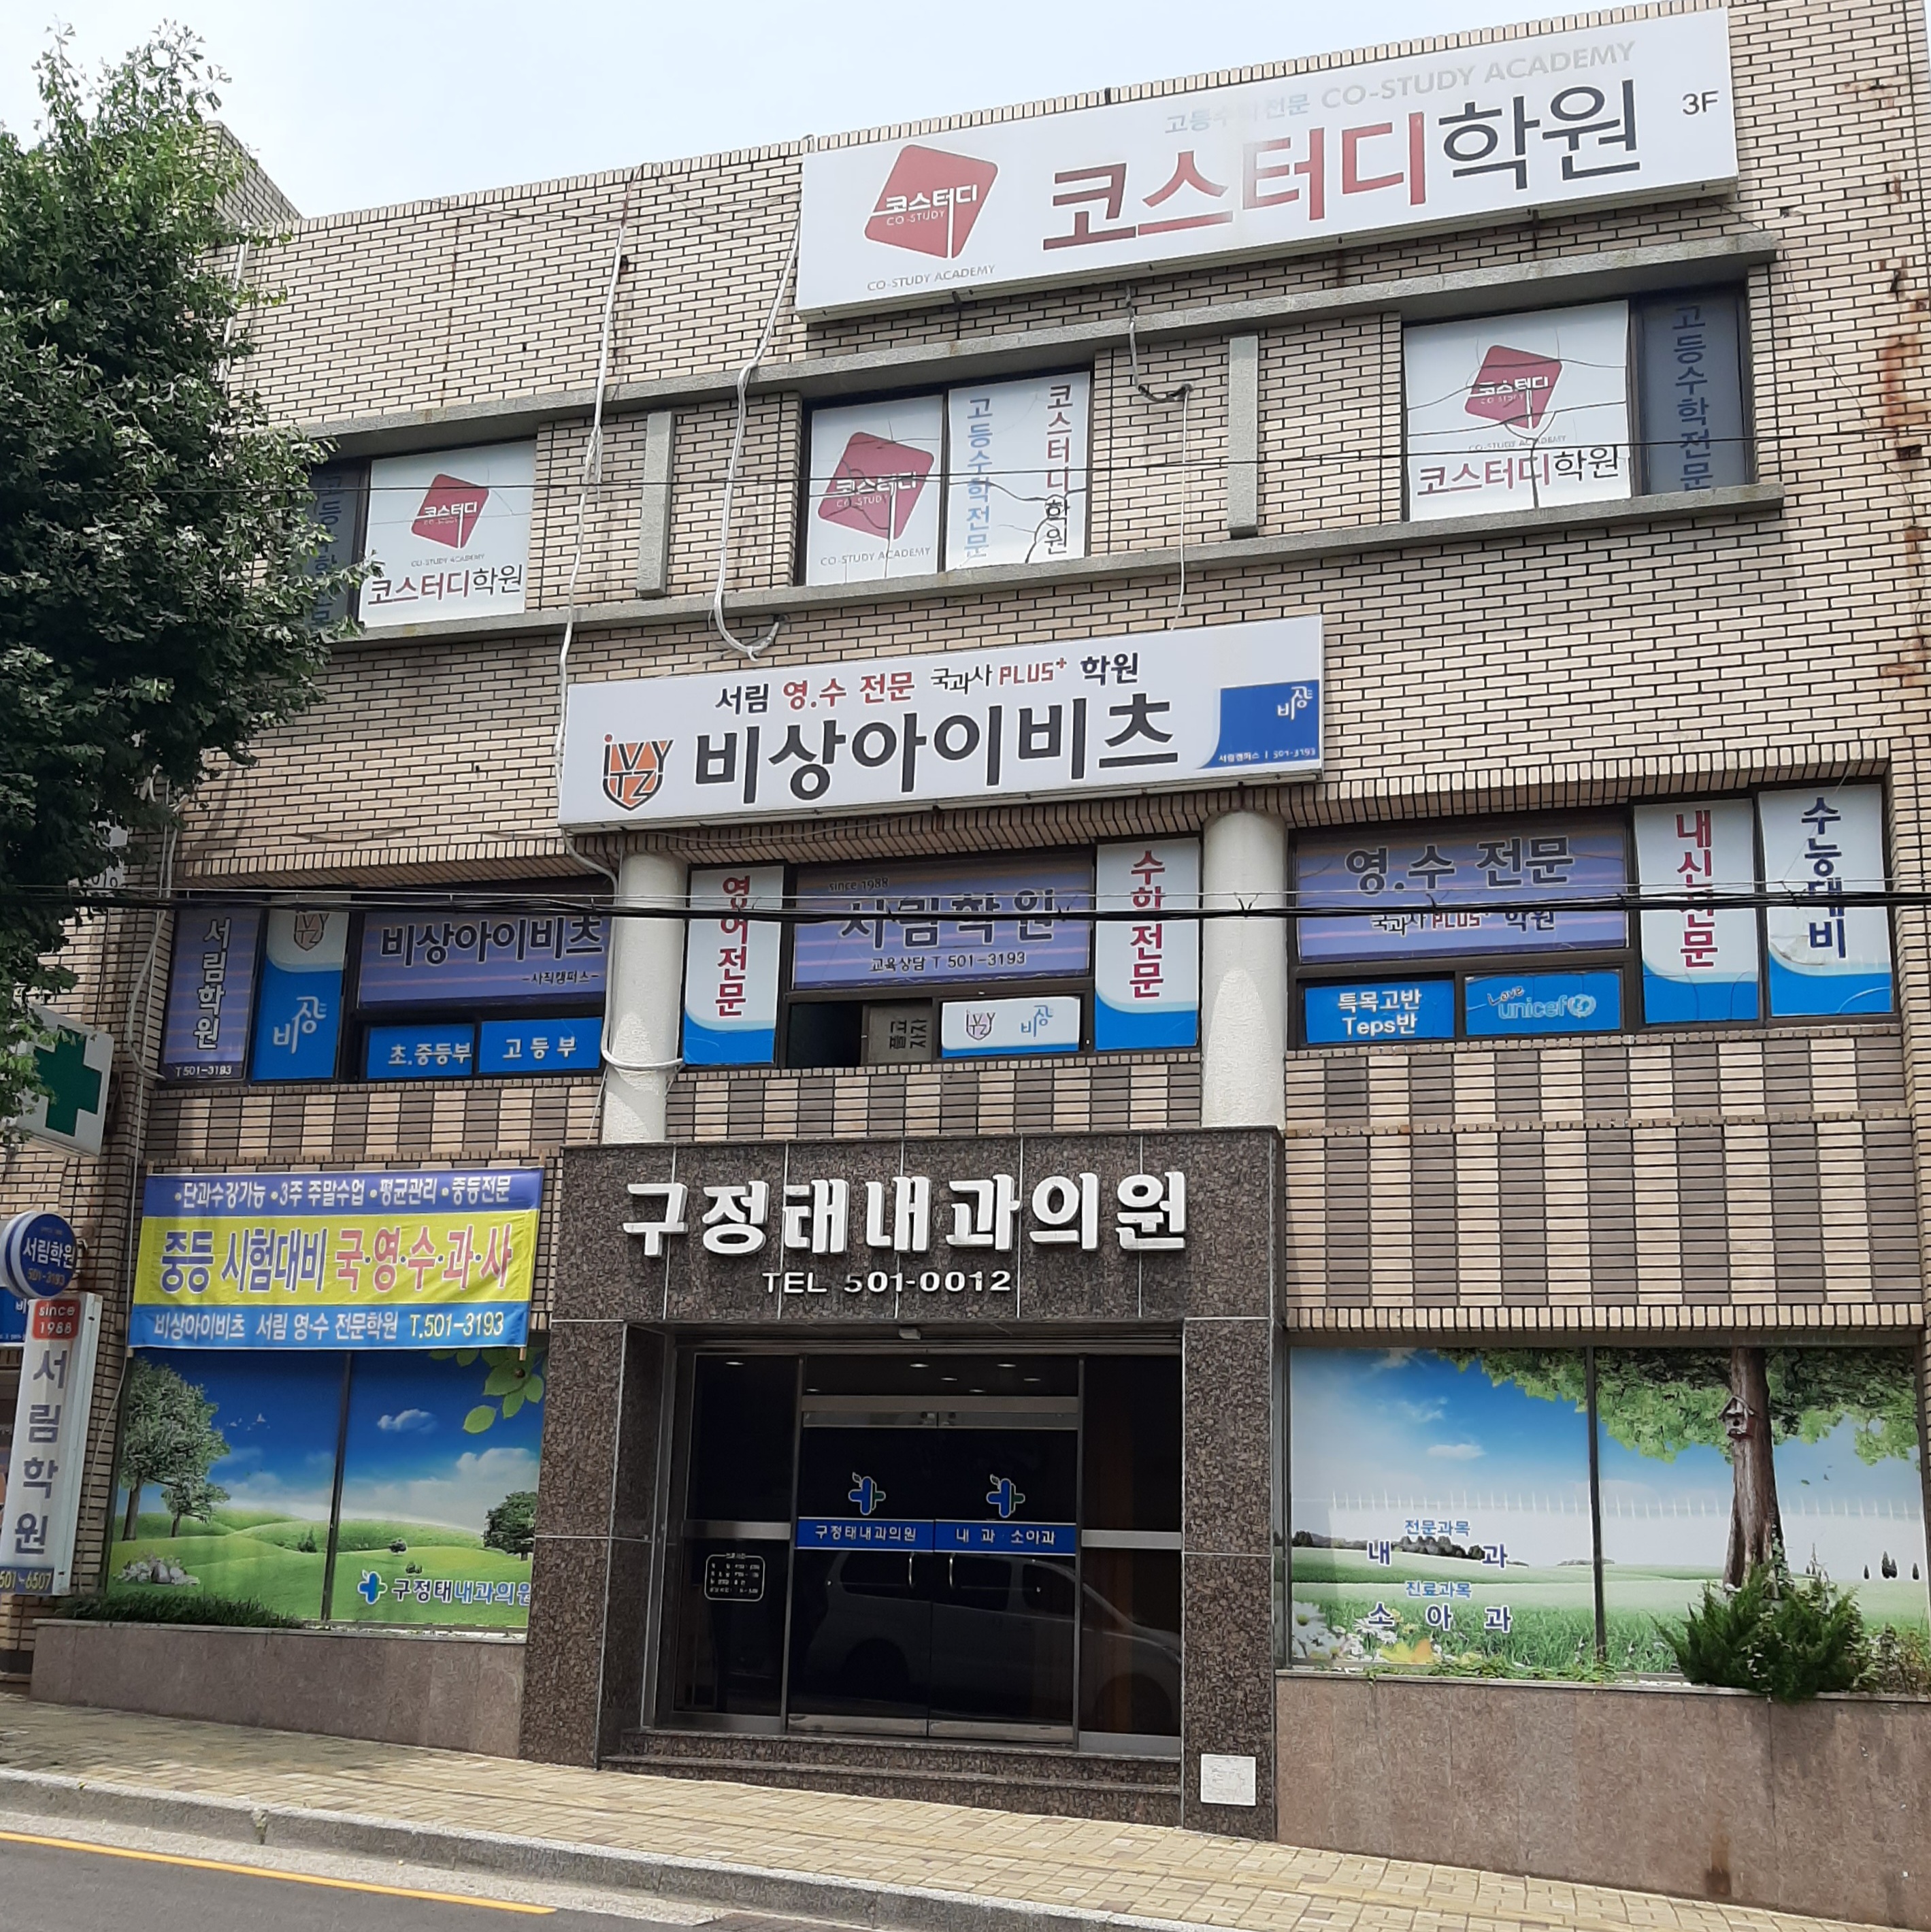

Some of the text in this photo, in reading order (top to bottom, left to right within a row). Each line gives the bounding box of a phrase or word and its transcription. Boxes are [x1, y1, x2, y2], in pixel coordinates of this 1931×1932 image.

[1321, 40, 1636, 110] CO-STUDY ACADEMY
[1682, 90, 1720, 116] 3F
[1042, 78, 1641, 250] 코스터디학원
[873, 184, 978, 214] 코스터디
[887, 210, 946, 227] CO-STUDY
[867, 264, 995, 292] CO-STUDY ACADEMY
[1471, 376, 1549, 397] 코스터디
[1417, 446, 1620, 497] 코스터디학원
[416, 501, 478, 519] 코스터디
[821, 546, 931, 566] CO-STUDY ACADEMY
[367, 564, 523, 606] 코스터디학원
[715, 683, 770, 715] 서림
[783, 678, 846, 710] 영.수
[860, 672, 915, 704] 전문
[931, 664, 992, 695] 국과사
[1080, 653, 1140, 686] 학원
[1276, 685, 1314, 721] 비상
[695, 693, 1178, 804] 비상아이비츠
[1476, 836, 1574, 888] 전문
[828, 877, 890, 892] since 1988
[1801, 797, 1847, 959] 수능대비
[840, 887, 1055, 950] 서림학원
[381, 917, 604, 968] 비상아이비츠
[868, 955, 927, 973] 교육상담
[948, 951, 1026, 969] 501-3193
[193, 918, 231, 1049] 서림학원
[1487, 985, 1525, 1006] Love
[1338, 988, 1422, 1013] 특목고반
[1498, 994, 1568, 1019] unicef
[273, 996, 327, 1054] 비상
[1021, 1004, 1053, 1037] 비상
[1342, 1013, 1418, 1037] Teps반
[503, 1036, 577, 1060] 고등부
[182, 1175, 511, 1209] 단과수강가능 3주 주말수업 평균관리 중등전문
[623, 1170, 1188, 1258] 구정태내과의원
[22, 1237, 76, 1270] 서림학원
[161, 1230, 214, 1294] 중등
[221, 1228, 328, 1293] 시험대비
[761, 1269, 1012, 1294] TEL 501-0012
[39, 1303, 76, 1317] since
[39, 1322, 72, 1335] 1988
[154, 1311, 246, 1341] 비상아이비츠
[256, 1312, 288, 1341] 서림
[335, 1311, 399, 1341] 전문학원
[15, 1349, 68, 1555] 서림학원
[814, 1524, 917, 1543] 구정태내과의원
[1010, 1529, 1057, 1546] 소아과
[1404, 1520, 1471, 1537] 전문과목
[393, 1578, 531, 1605] 구정태내과의원
[1406, 1581, 1472, 1599] 진료과목
